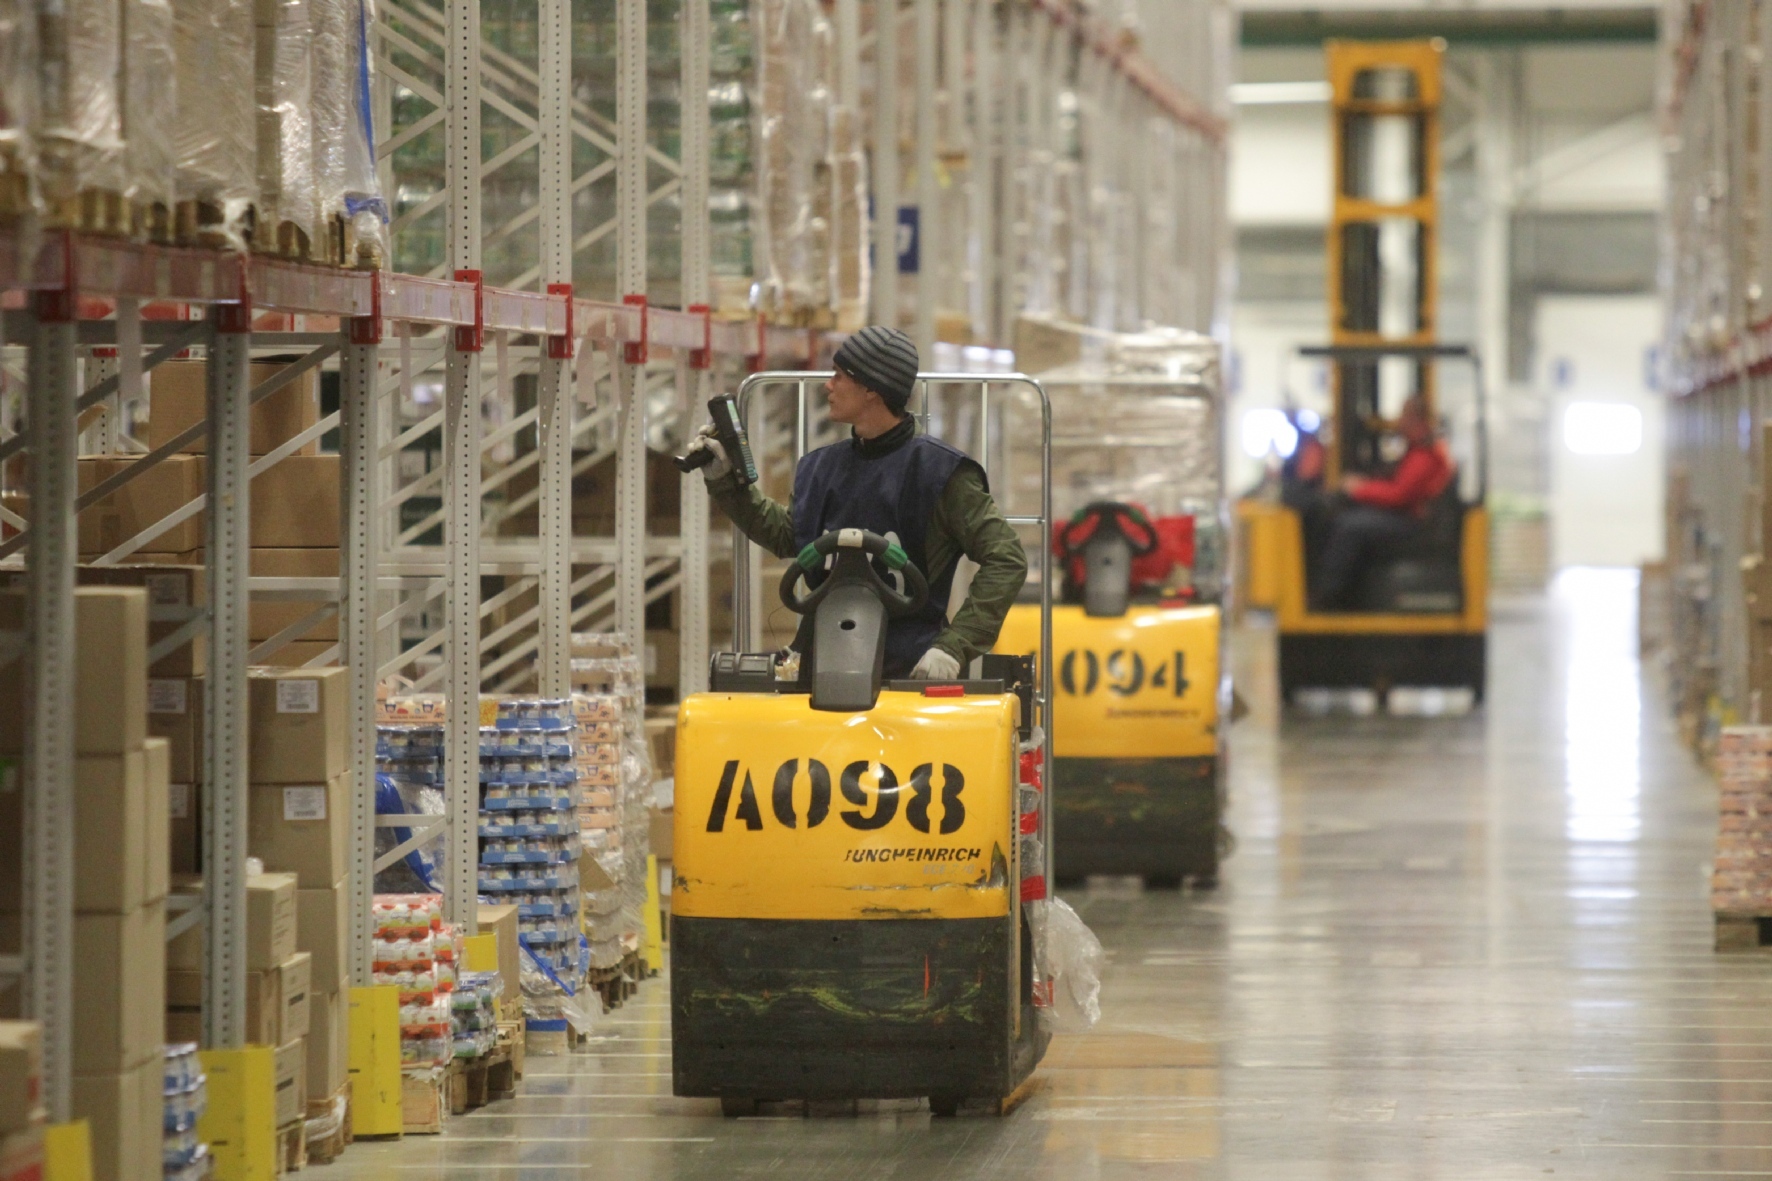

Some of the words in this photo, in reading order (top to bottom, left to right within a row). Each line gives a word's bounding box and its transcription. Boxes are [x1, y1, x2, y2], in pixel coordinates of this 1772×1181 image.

[1053, 649, 1190, 697] 094
[706, 758, 965, 834] A098
[845, 848, 981, 862] JUNGHEINRICH
